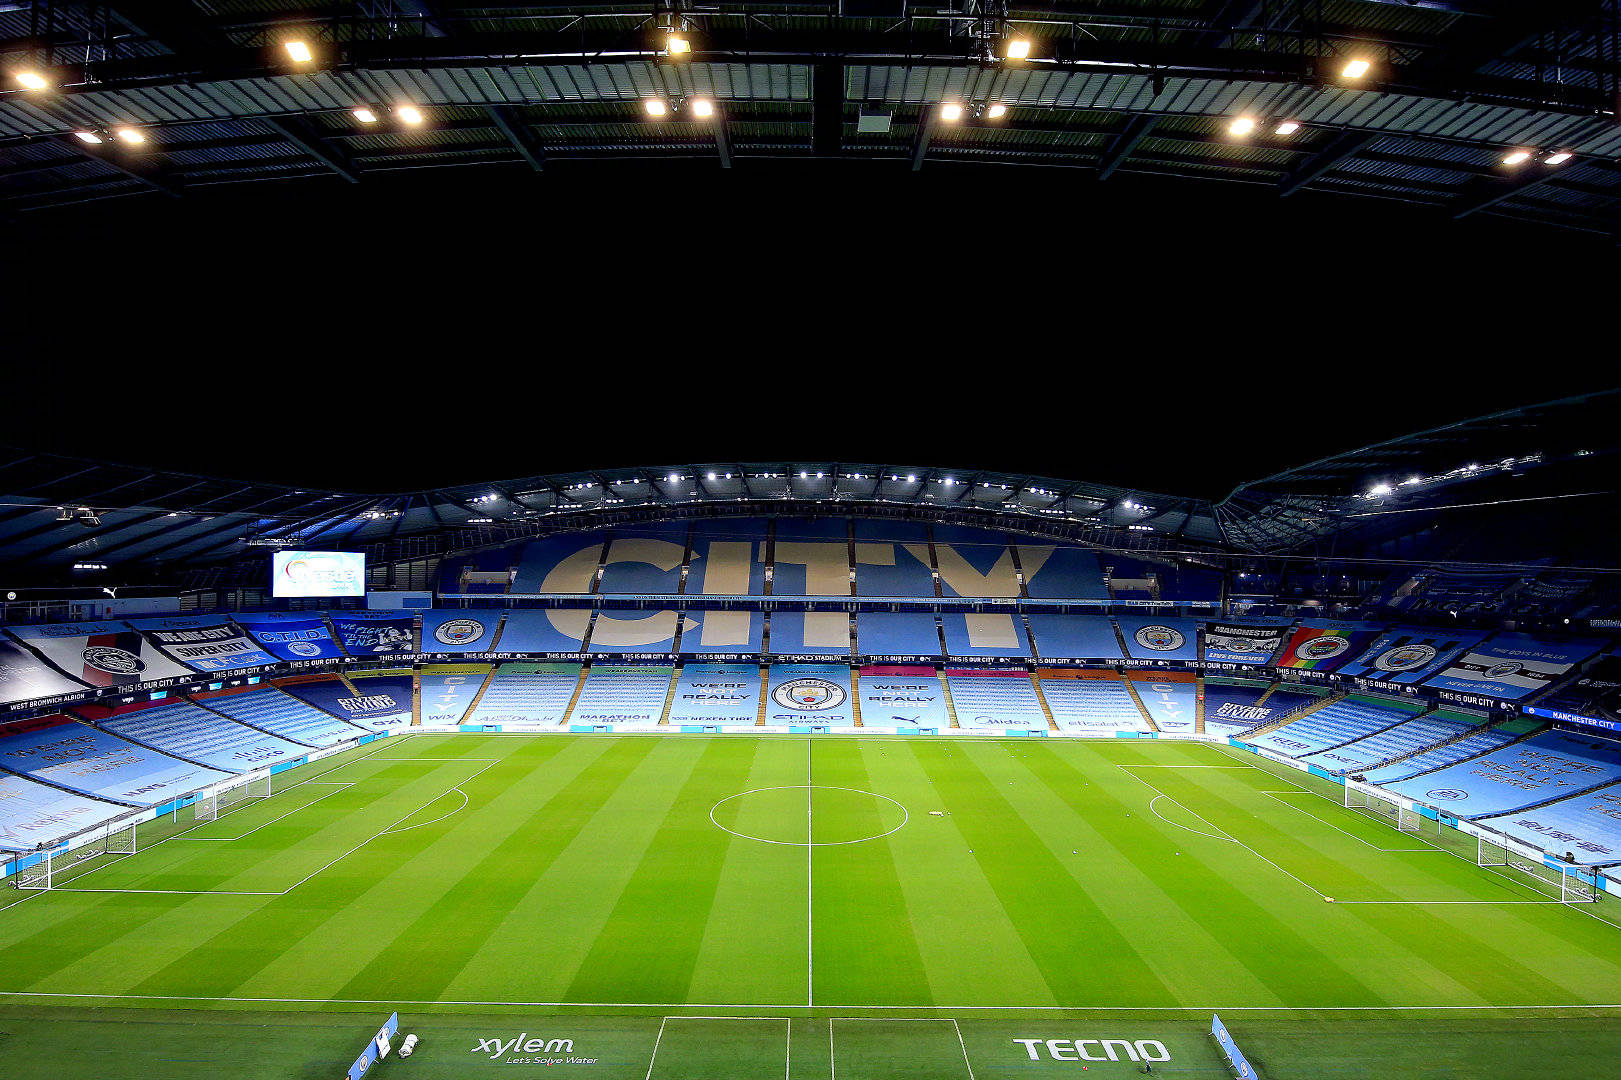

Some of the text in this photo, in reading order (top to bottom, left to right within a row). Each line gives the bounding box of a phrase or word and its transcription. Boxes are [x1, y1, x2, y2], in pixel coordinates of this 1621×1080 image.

[540, 538, 1057, 648] CITY
[152, 627, 235, 642] WE ARE CITY
[1214, 626, 1278, 637] MANCHESTER
[176, 641, 251, 658] SUPER CITY
[290, 661, 304, 669] THIS
[213, 671, 227, 679] THIS
[234, 668, 247, 676] OUR
[247, 666, 260, 674] CITY
[1275, 667, 1290, 675] THIS
[1298, 669, 1311, 677] OUR
[1311, 670, 1326, 678] CITY
[118, 679, 174, 693] THIS IS OUR CITY
[781, 680, 838, 691] MANCHESTER
[1354, 677, 1402, 690] THIS IS OUR CITY
[10, 692, 85, 711] WEST BROMWICH ALBION
[342, 698, 397, 711] GIVING
[1439, 691, 1495, 707] THIS IS OUR CITY
[1552, 711, 1615, 729] MANCHESTER CITY
[40, 744, 99, 761] NOT
[471, 1032, 574, 1059] xylem
[1012, 1038, 1172, 1062] TECNO
[505, 1055, 599, 1066] Let's Solve Water
